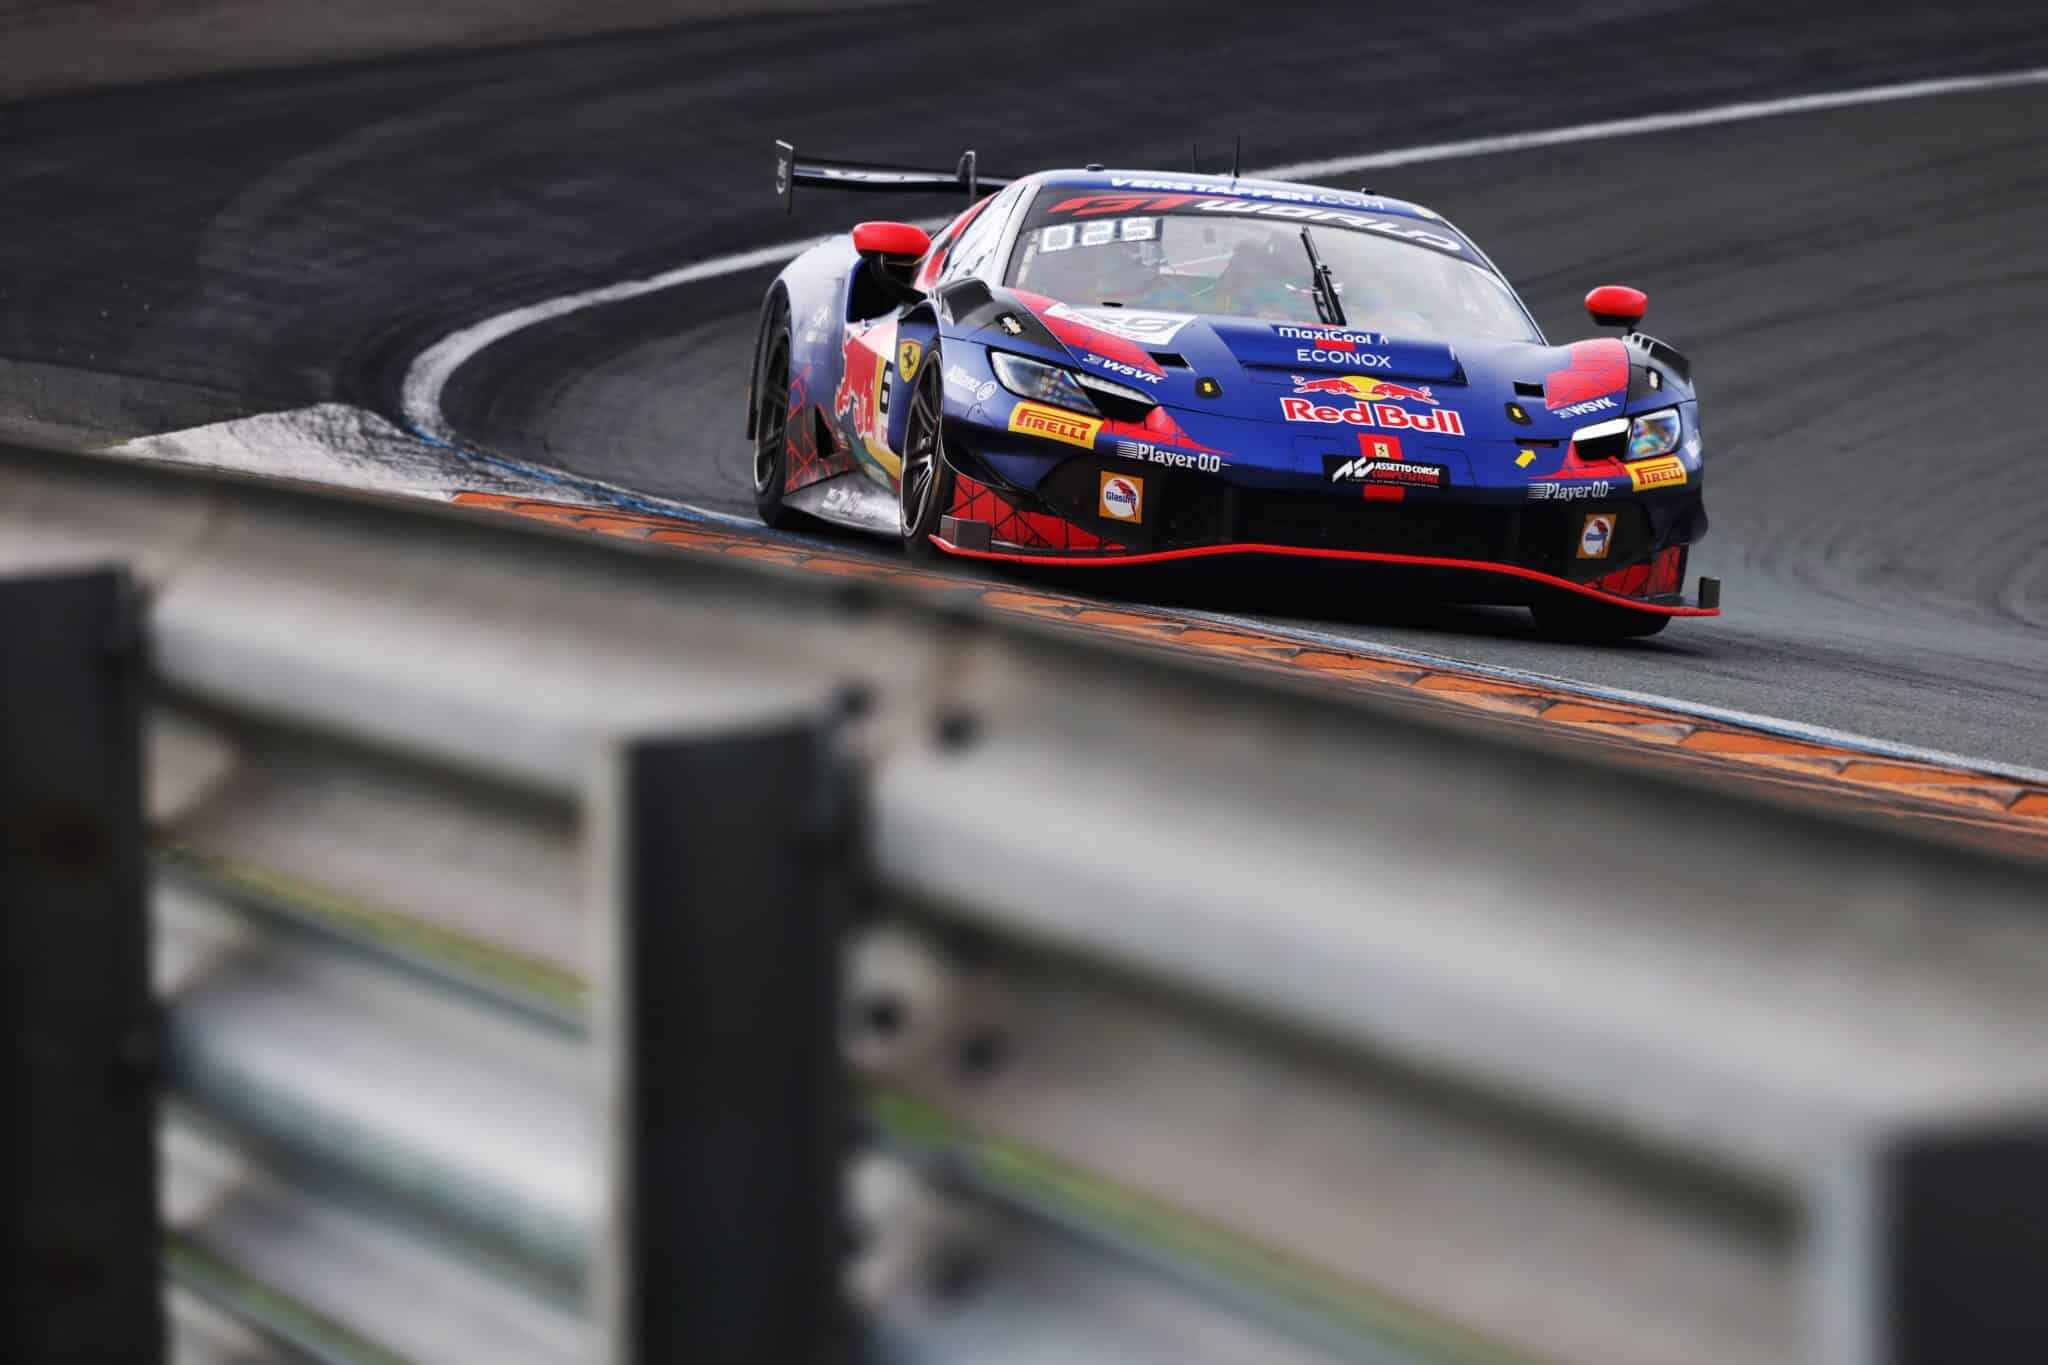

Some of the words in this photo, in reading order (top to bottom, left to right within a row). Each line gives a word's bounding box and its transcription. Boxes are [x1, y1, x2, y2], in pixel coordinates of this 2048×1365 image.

[1194, 199, 1461, 251] WORLD
[1279, 327, 1371, 345] maxiCool
[1297, 349, 1392, 369] ECONOX
[1103, 360, 1164, 384] WSVK
[1281, 398, 1375, 426] Red
[1374, 404, 1465, 436] Bull
[1570, 396, 1618, 417] WSVK
[1016, 407, 1091, 441] PIRELLI
[1137, 443, 1197, 469] Player
[1375, 462, 1412, 473] ASSETTO
[1412, 465, 1440, 477] CORSA
[1635, 463, 1684, 485] PIRELLI
[1544, 483, 1592, 501] Player
